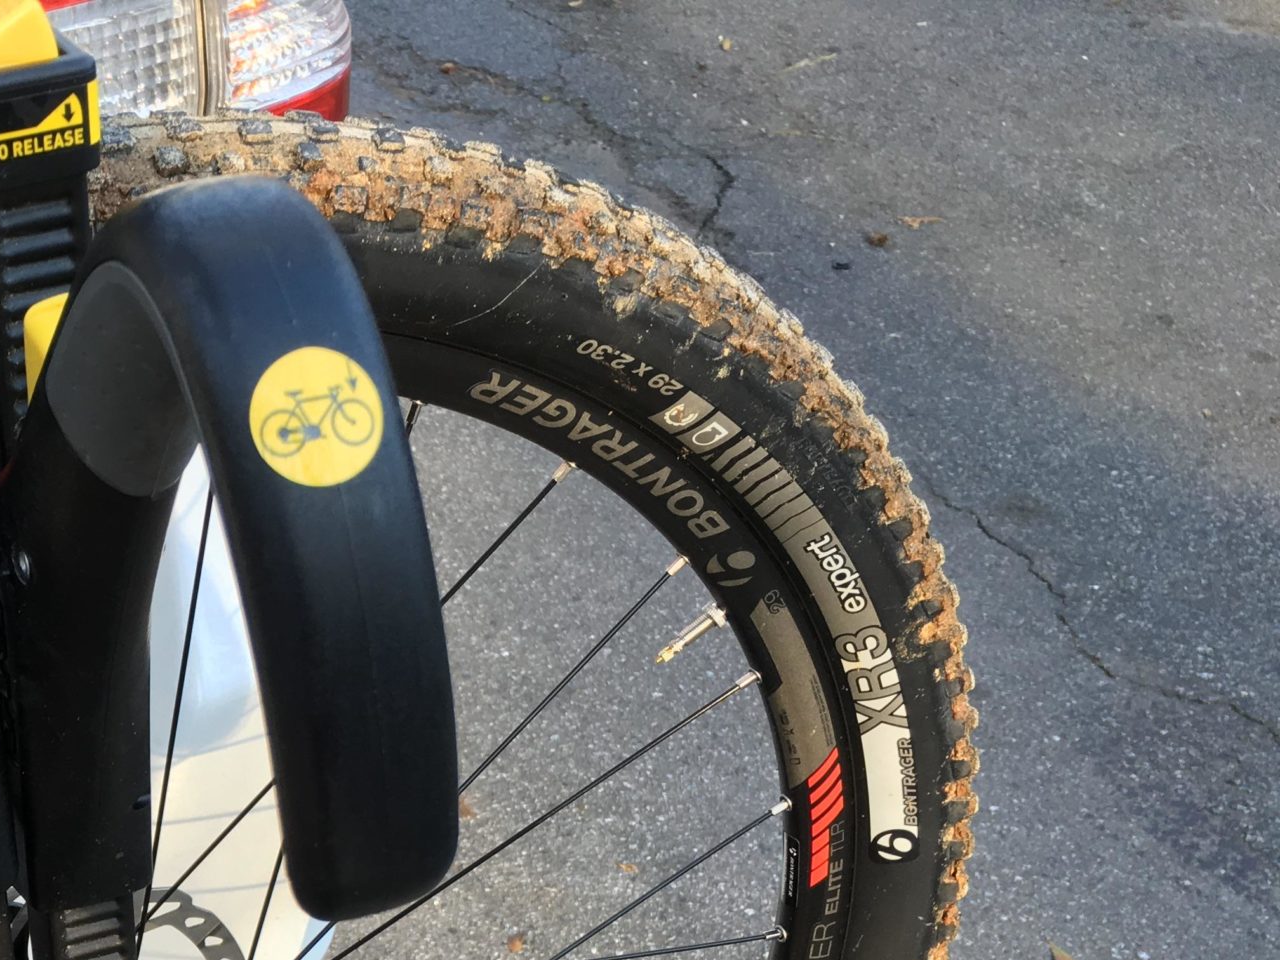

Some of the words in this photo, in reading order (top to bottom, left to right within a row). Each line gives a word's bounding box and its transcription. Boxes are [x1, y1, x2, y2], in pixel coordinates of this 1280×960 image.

[12, 127, 85, 158] RELEASE
[576, 339, 635, 369] 2.30
[647, 373, 685, 396] 29
[468, 370, 731, 539] BONTRAGER
[803, 532, 867, 614] expert
[834, 624, 911, 736] XR3
[897, 737, 918, 827] BONTRAGER
[830, 820, 846, 857] TLR
[824, 858, 844, 916] ELITE
